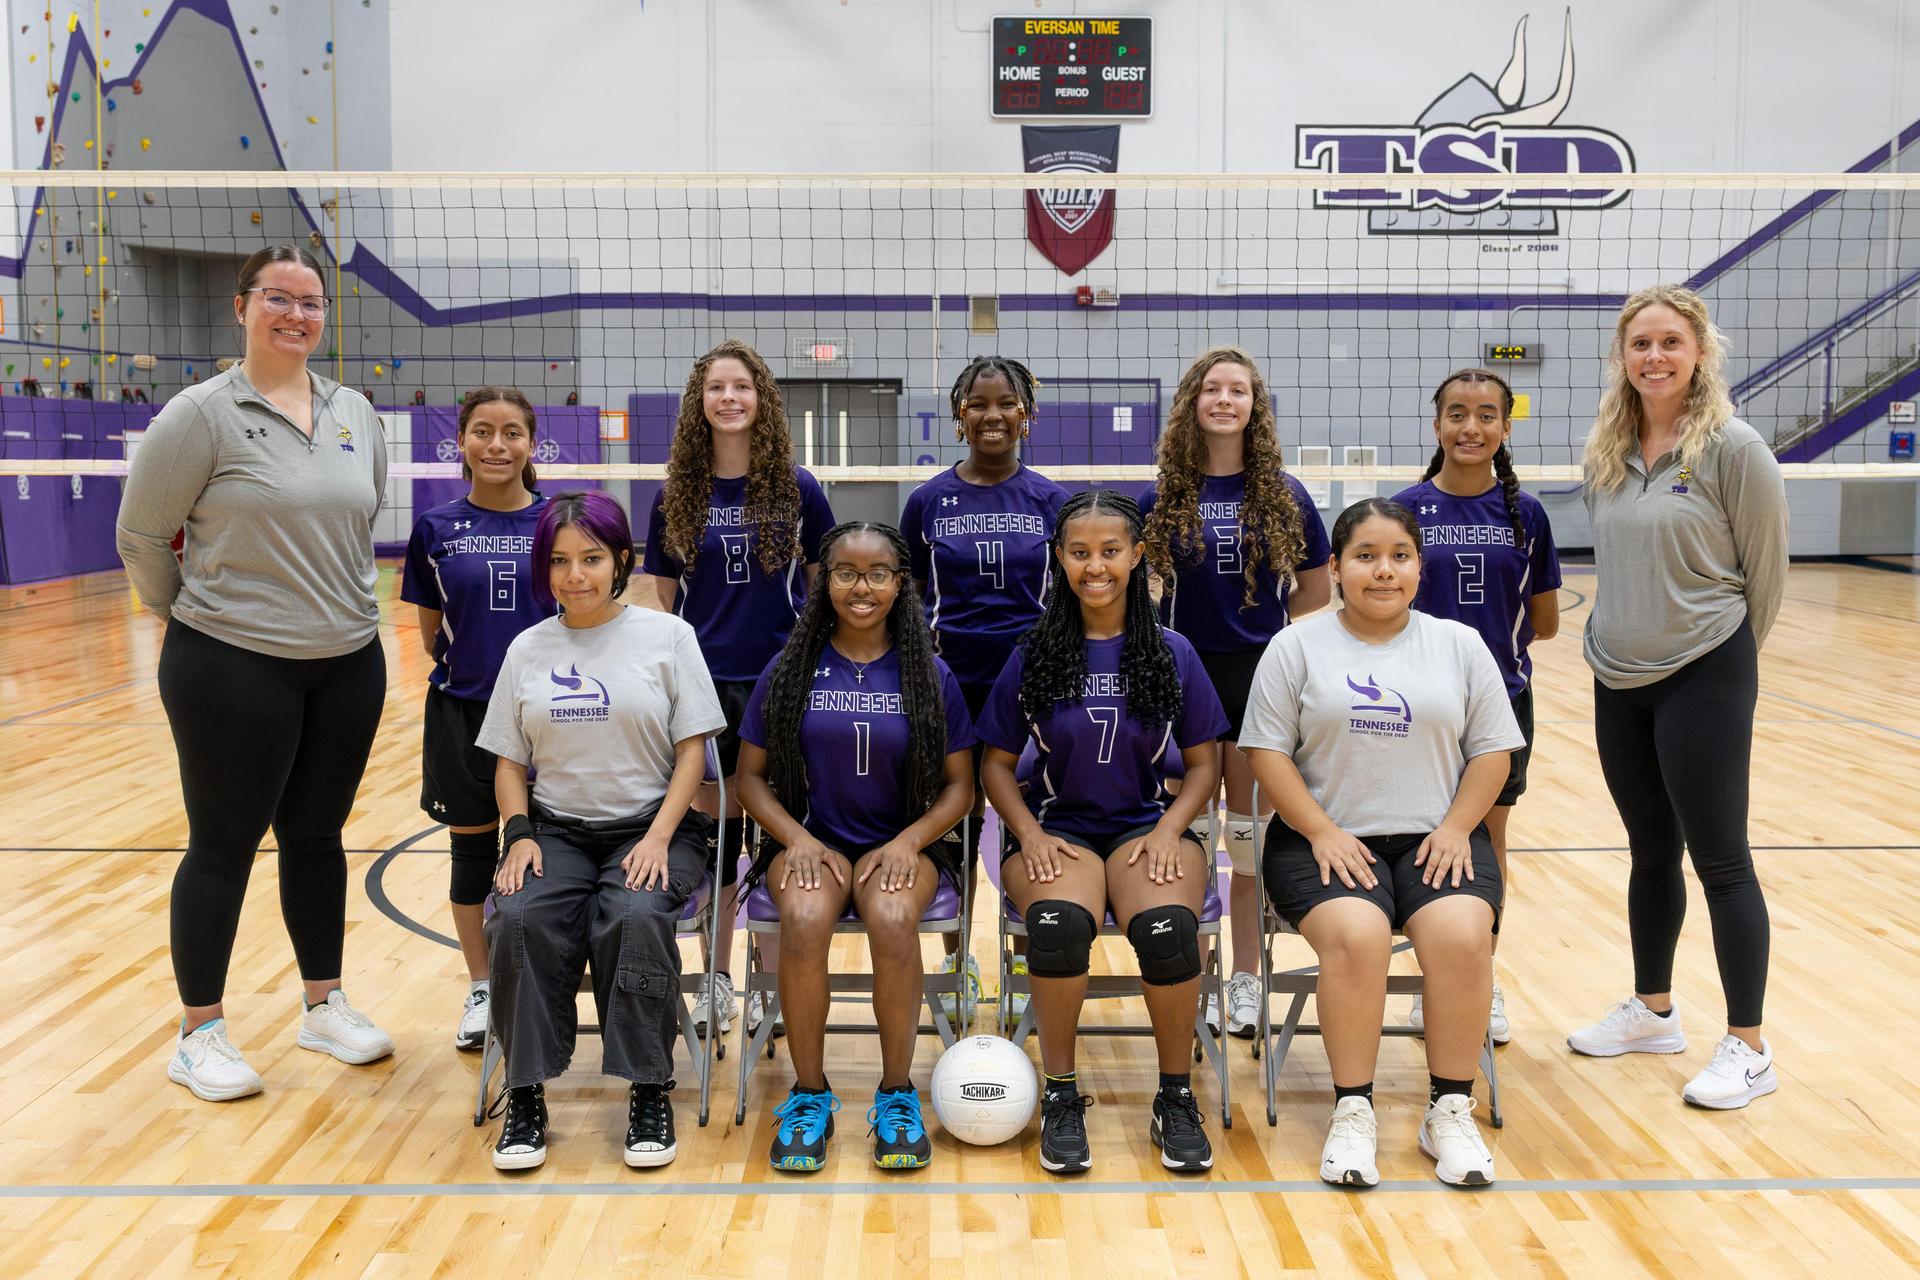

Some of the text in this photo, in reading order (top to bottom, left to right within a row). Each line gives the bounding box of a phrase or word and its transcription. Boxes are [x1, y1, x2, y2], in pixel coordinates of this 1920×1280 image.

[1024, 20, 1120, 35] EVERSAN TIME
[1018, 45, 1027, 56] P
[1118, 46, 1127, 57] P
[999, 66, 1041, 81] HOME
[1058, 66, 1087, 75] BONUS
[1102, 66, 1146, 81] GUEST
[1055, 87, 1090, 97] PERIOD
[1295, 122, 1637, 213] TSD
[1042, 188, 1099, 204] NDIAA
[1482, 244, 1510, 252] Class
[934, 513, 1044, 537] TENNESSEE
[1420, 525, 1526, 549] ENNESSE
[443, 536, 534, 556] TENNESS
[1213, 526, 1242, 574] 3
[720, 533, 750, 584] 8
[975, 541, 1004, 589] 4
[487, 560, 516, 611] 6
[1455, 553, 1484, 604] 2
[550, 707, 609, 718] TENNESSEE
[1349, 718, 1409, 733] TENNESSEE
[1086, 707, 1118, 763] 7
[853, 721, 870, 775] 1
[960, 1083, 1006, 1099] TACHIKARA
